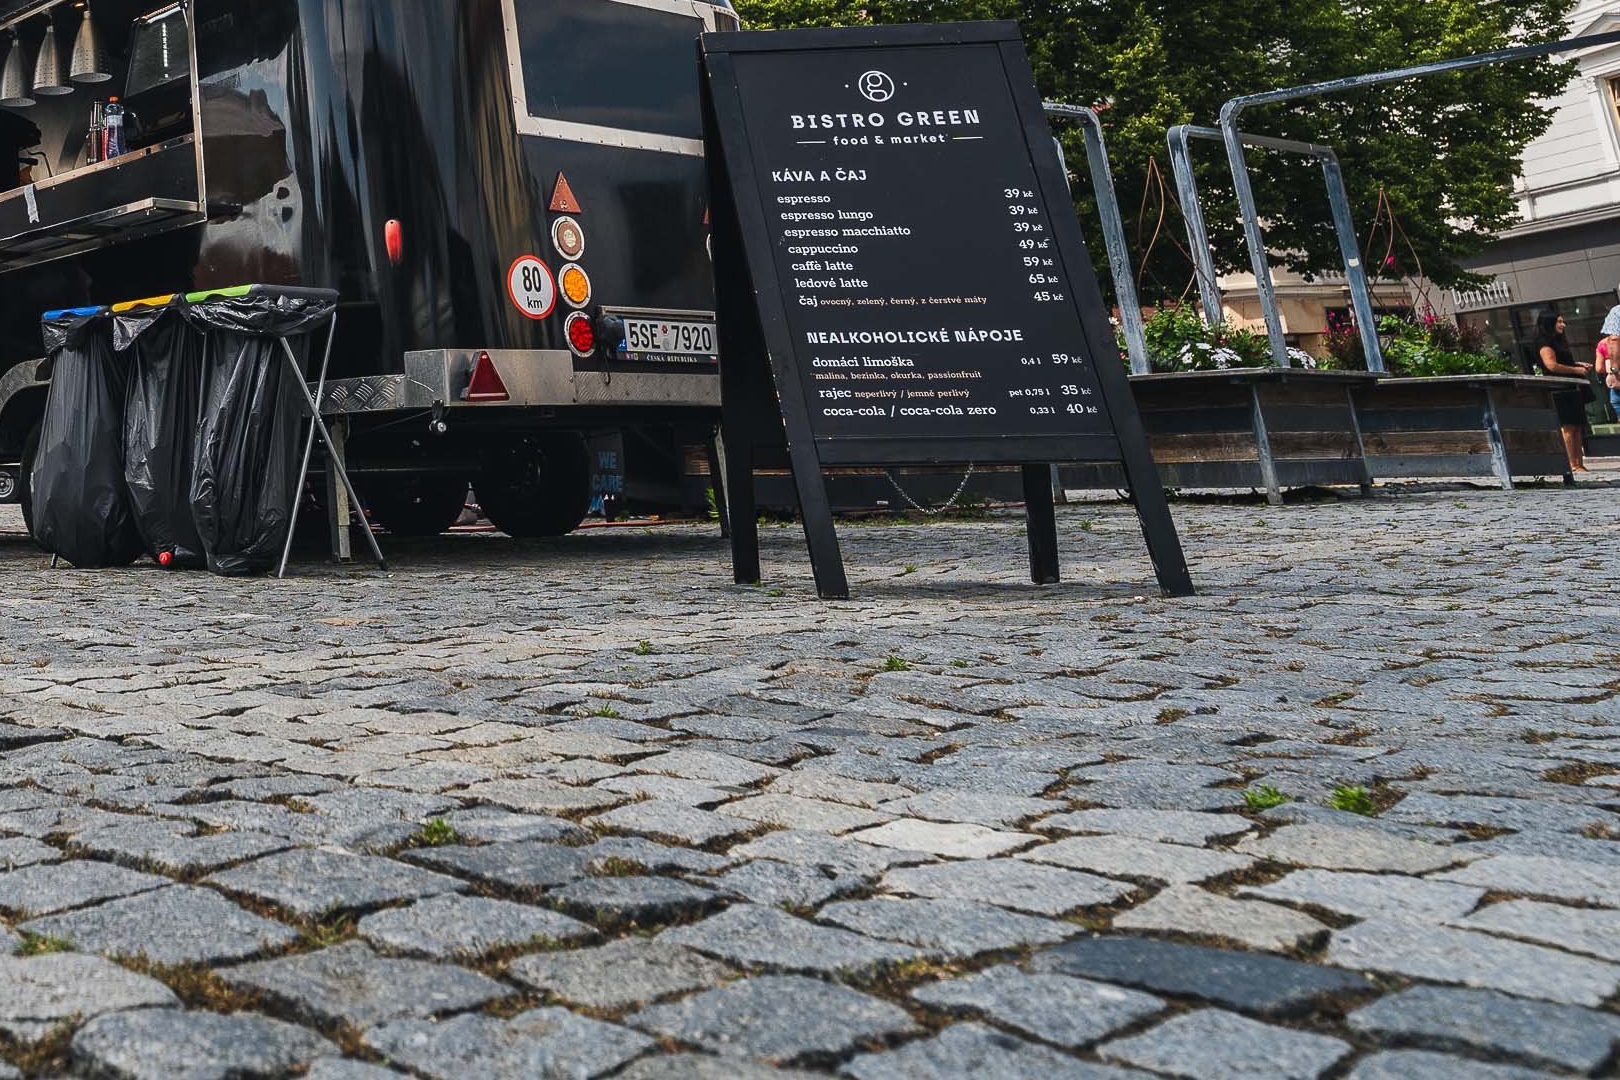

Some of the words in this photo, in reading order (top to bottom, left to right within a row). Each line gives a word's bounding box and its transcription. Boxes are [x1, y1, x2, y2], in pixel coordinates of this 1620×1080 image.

[790, 112, 885, 129] BISTRO
[897, 109, 980, 126] GREEN
[833, 135, 868, 146] food
[874, 135, 884, 145] &
[890, 133, 946, 144] market
[772, 168, 815, 182] KÁVA
[820, 170, 830, 181] A
[835, 167, 867, 181] ČAJ
[1004, 188, 1020, 198] 39
[777, 195, 831, 205] espresso
[780, 212, 834, 222] espresso
[837, 210, 874, 222] lungo
[1009, 205, 1024, 215] 39
[784, 228, 839, 239] espresso
[842, 226, 911, 236] macchiatto
[1013, 222, 1029, 232] 39
[788, 244, 859, 256] cappuccino
[1019, 239, 1034, 249] 49
[791, 261, 822, 271] caffè
[825, 261, 854, 271] latte
[1023, 256, 1039, 266] 59
[522, 266, 542, 292] 80
[794, 278, 836, 288] ledové
[839, 278, 868, 288] latte
[1029, 273, 1045, 283] 65
[526, 296, 543, 308] km
[799, 295, 818, 308] čaj
[820, 298, 854, 306] ovocný,
[857, 297, 888, 306] zelený,
[890, 297, 919, 306] černý,
[929, 296, 962, 304] čerstvé
[964, 296, 987, 304] máty
[1034, 291, 1050, 301] 45
[628, 322, 660, 348] 5SE
[671, 324, 712, 350] 7920
[806, 328, 950, 344] NEALKOHOLICKÉ
[954, 328, 1024, 342] NÁPOJE
[862, 356, 914, 367] limoška
[1052, 354, 1068, 364] 59
[928, 370, 982, 380] passionfruit
[819, 388, 852, 400] rajec
[854, 389, 897, 398] neperlivý
[900, 390, 904, 398] /
[907, 390, 935, 398] jemně
[938, 389, 970, 398] perlivý
[1008, 389, 1023, 397] pet
[1061, 385, 1078, 395] 35
[823, 406, 886, 416] coca-cola
[891, 405, 895, 418] /
[900, 405, 963, 415] coca-cola
[967, 406, 996, 415] zero
[1066, 404, 1083, 414] 40
[598, 451, 618, 469] WE
